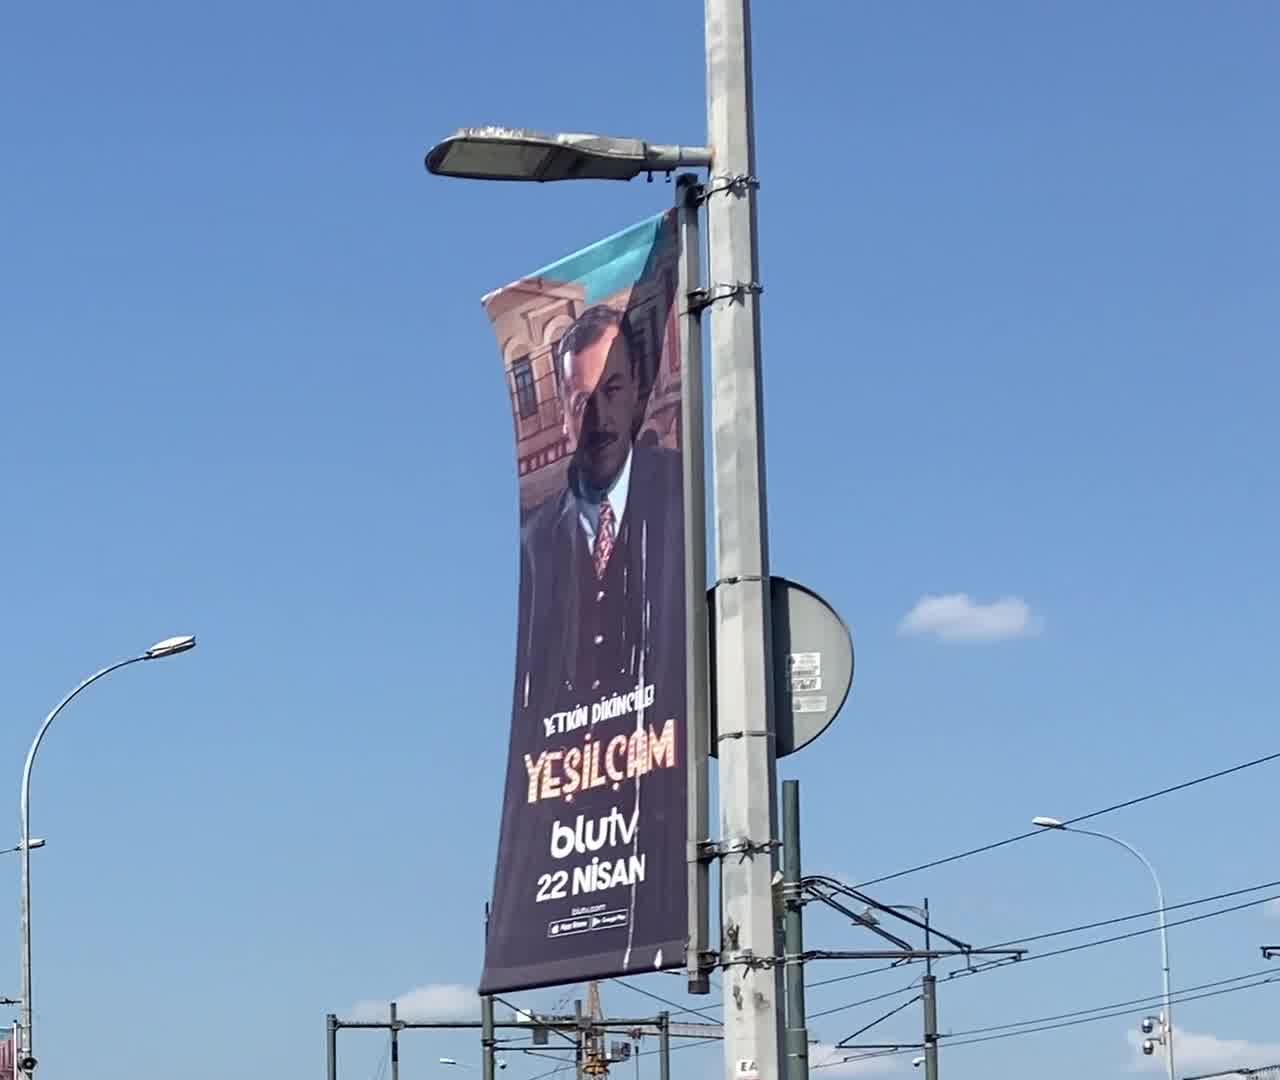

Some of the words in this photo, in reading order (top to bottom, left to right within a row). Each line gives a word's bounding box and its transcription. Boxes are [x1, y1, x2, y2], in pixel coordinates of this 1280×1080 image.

[524, 719, 676, 803] YEŞİLÇAM
[550, 806, 639, 859] blutv
[535, 870, 568, 902] 22
[572, 853, 646, 896] NİSAN
